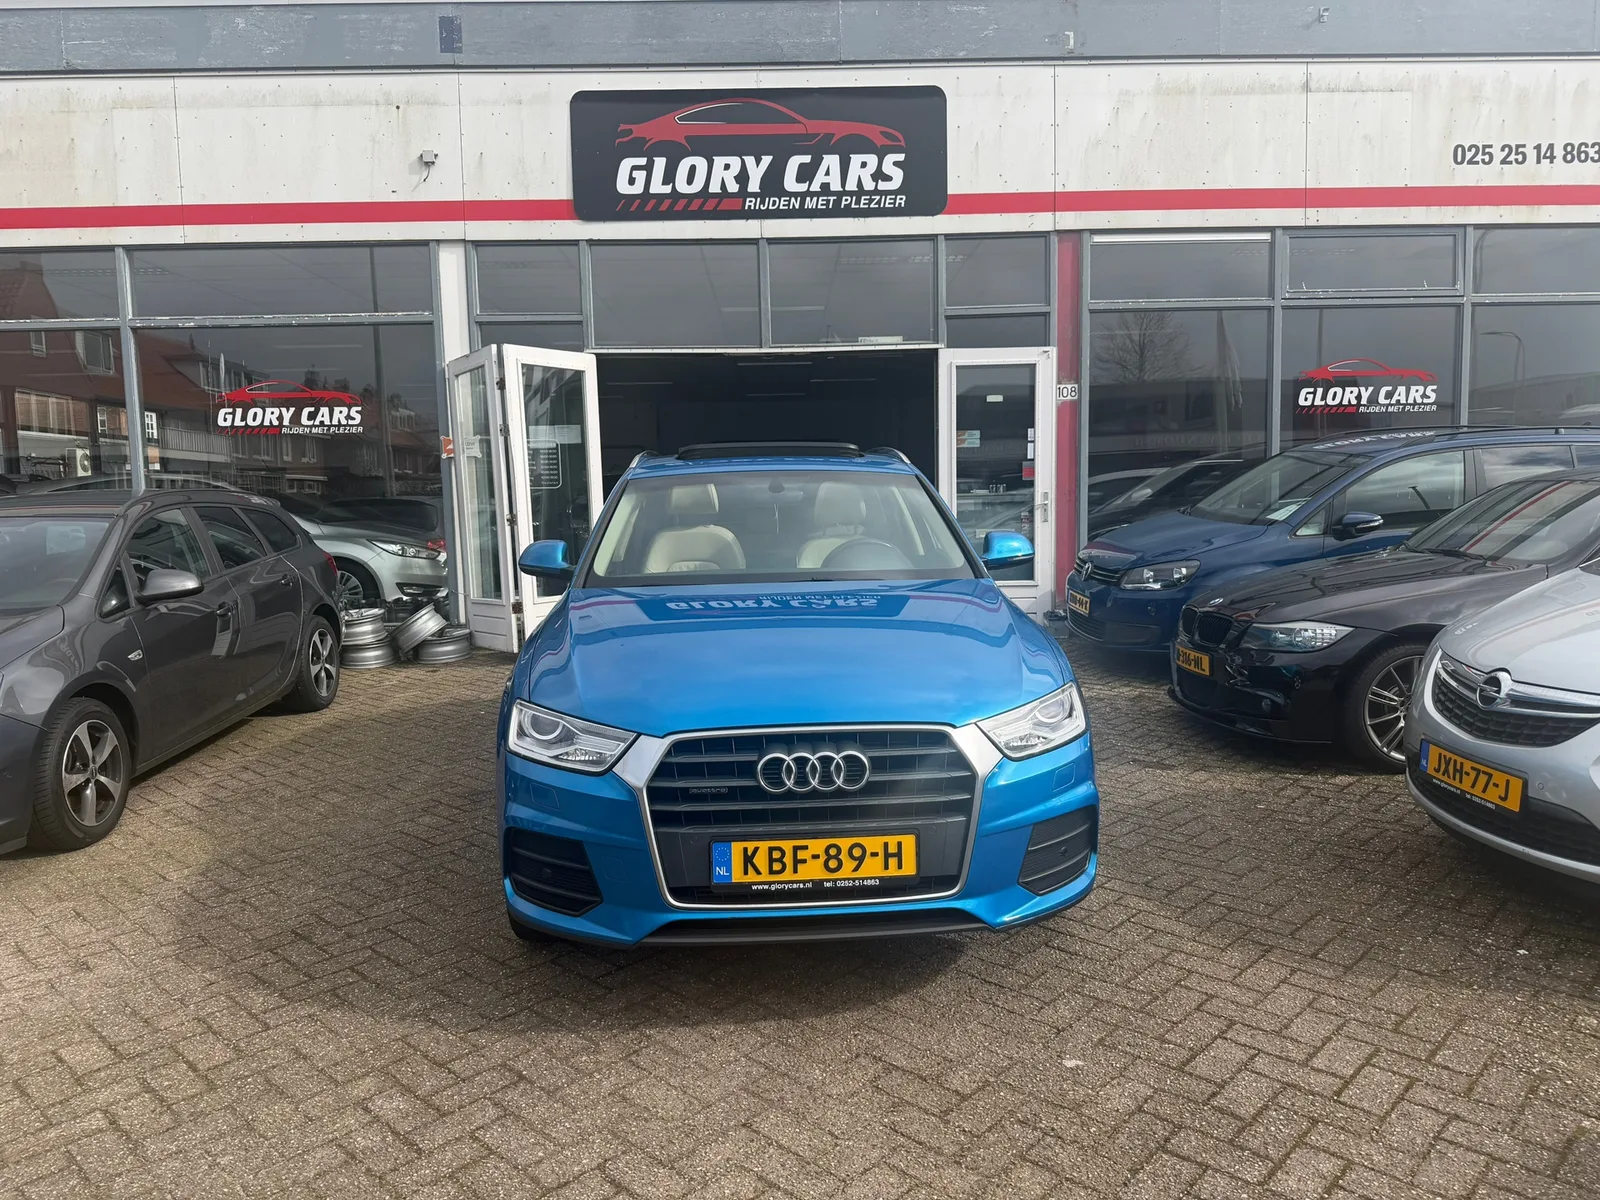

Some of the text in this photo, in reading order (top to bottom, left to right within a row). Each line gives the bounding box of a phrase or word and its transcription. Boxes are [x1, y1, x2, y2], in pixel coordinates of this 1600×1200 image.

[1453, 142, 1600, 165] 025 25 14 863
[616, 153, 906, 195] GLORY CARS
[745, 195, 906, 210] RIJDEN MET PLEZIER
[1057, 386, 1077, 398] 108
[1298, 385, 1438, 406] GLORY CARS
[217, 406, 363, 426] GLORY CARS
[1433, 752, 1511, 802] JXH-77-J
[742, 840, 904, 876] KBF-89-H
[716, 866, 730, 876] NL
[751, 879, 880, 890] www.glorycars.nl tel: 0252-514863
